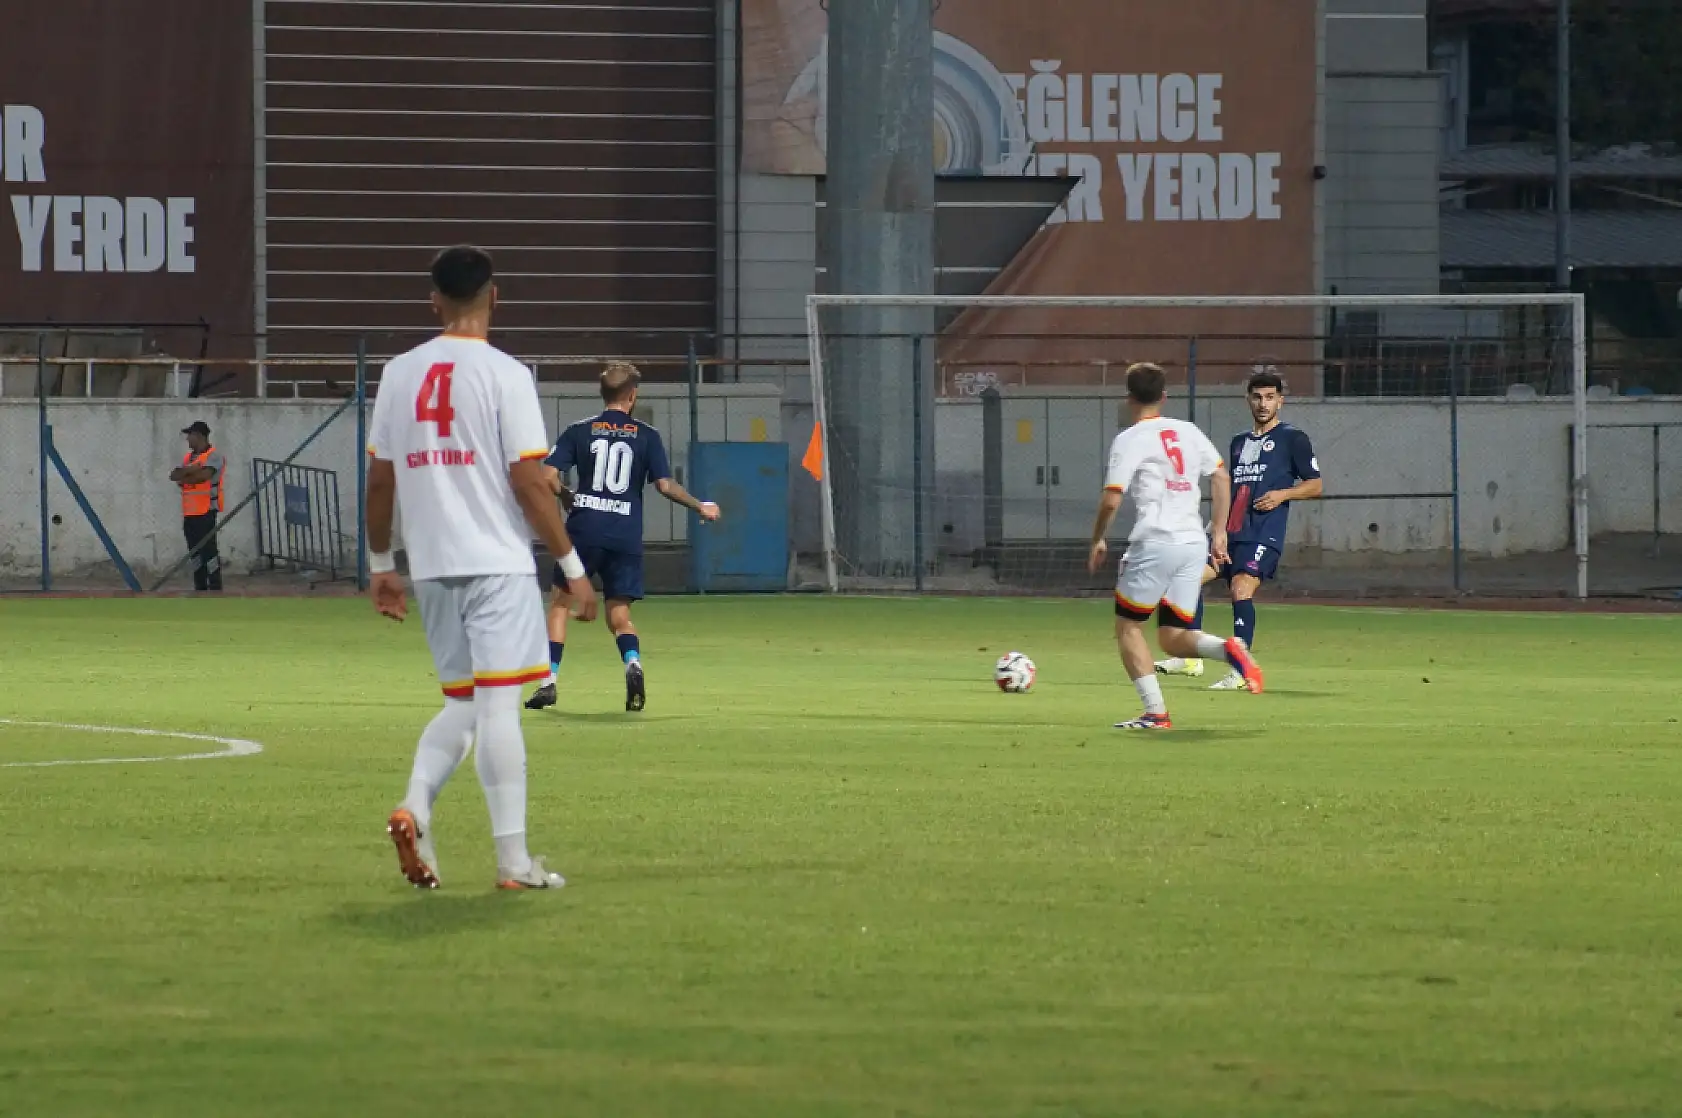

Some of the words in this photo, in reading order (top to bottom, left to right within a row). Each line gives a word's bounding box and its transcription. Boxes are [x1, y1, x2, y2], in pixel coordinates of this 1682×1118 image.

[0, 104, 47, 182] R
[1116, 152, 1281, 221] YERDE
[10, 195, 195, 272] YERDE
[415, 362, 455, 437] 4
[590, 438, 633, 494] 10
